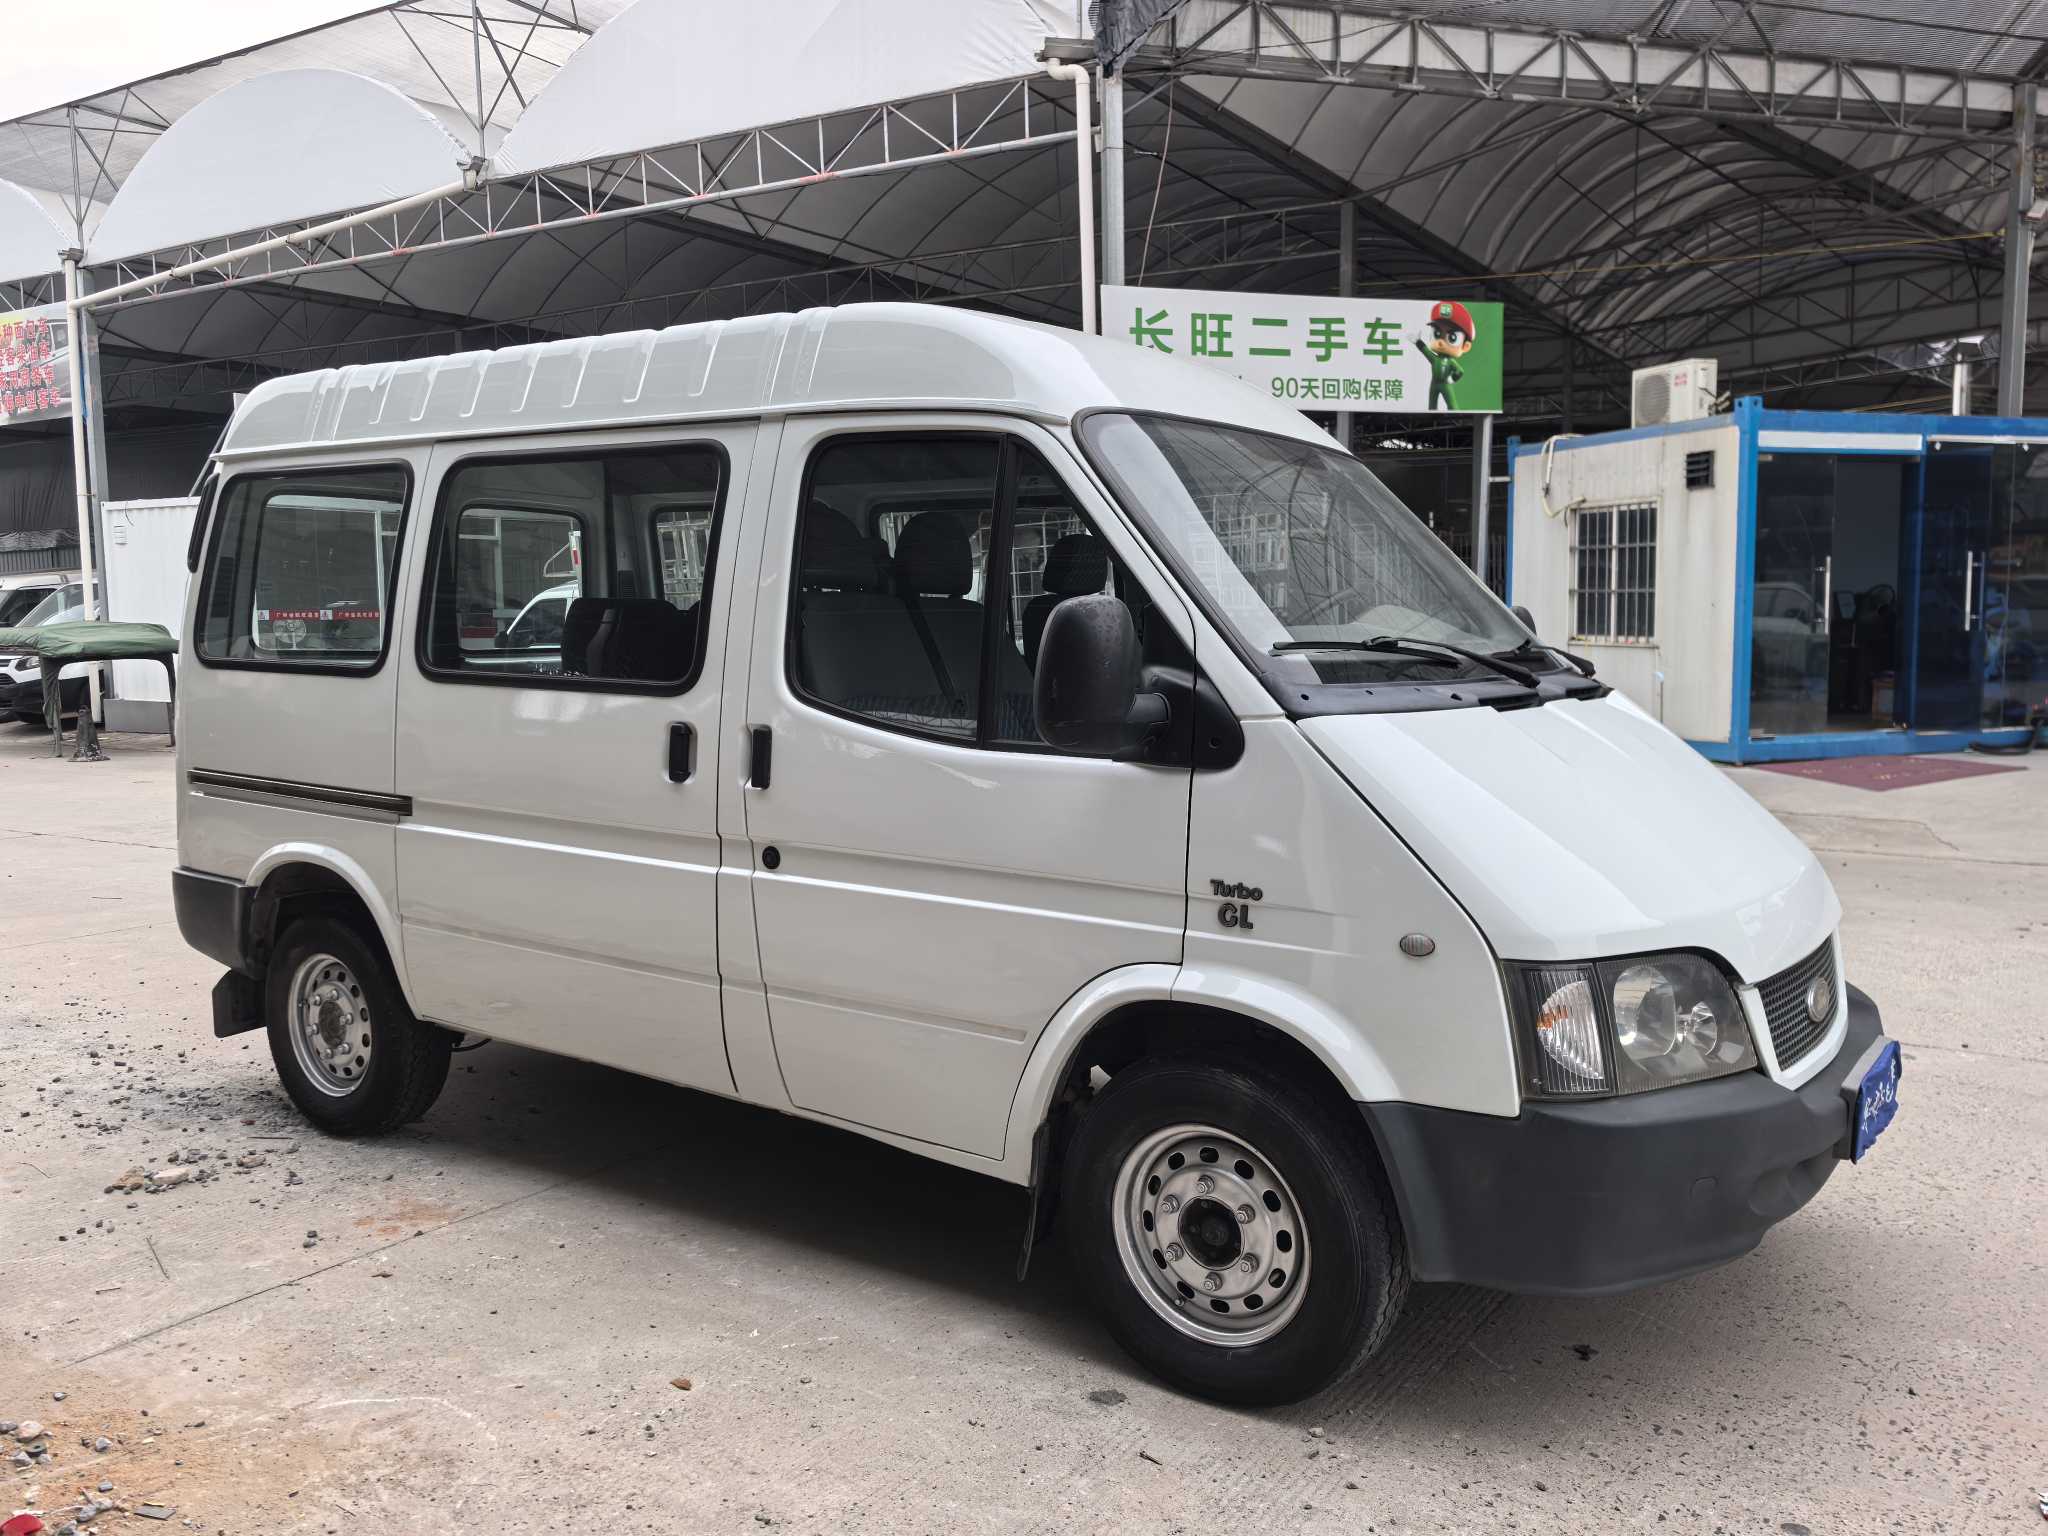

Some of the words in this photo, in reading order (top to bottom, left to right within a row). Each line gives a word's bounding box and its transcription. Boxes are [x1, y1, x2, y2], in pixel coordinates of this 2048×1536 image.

[1129, 307, 1404, 364] 长旺二手车
[1271, 377, 1403, 401] 90天回购保障
[1210, 879, 1263, 901] Turbo
[1218, 903, 1253, 929] GL
